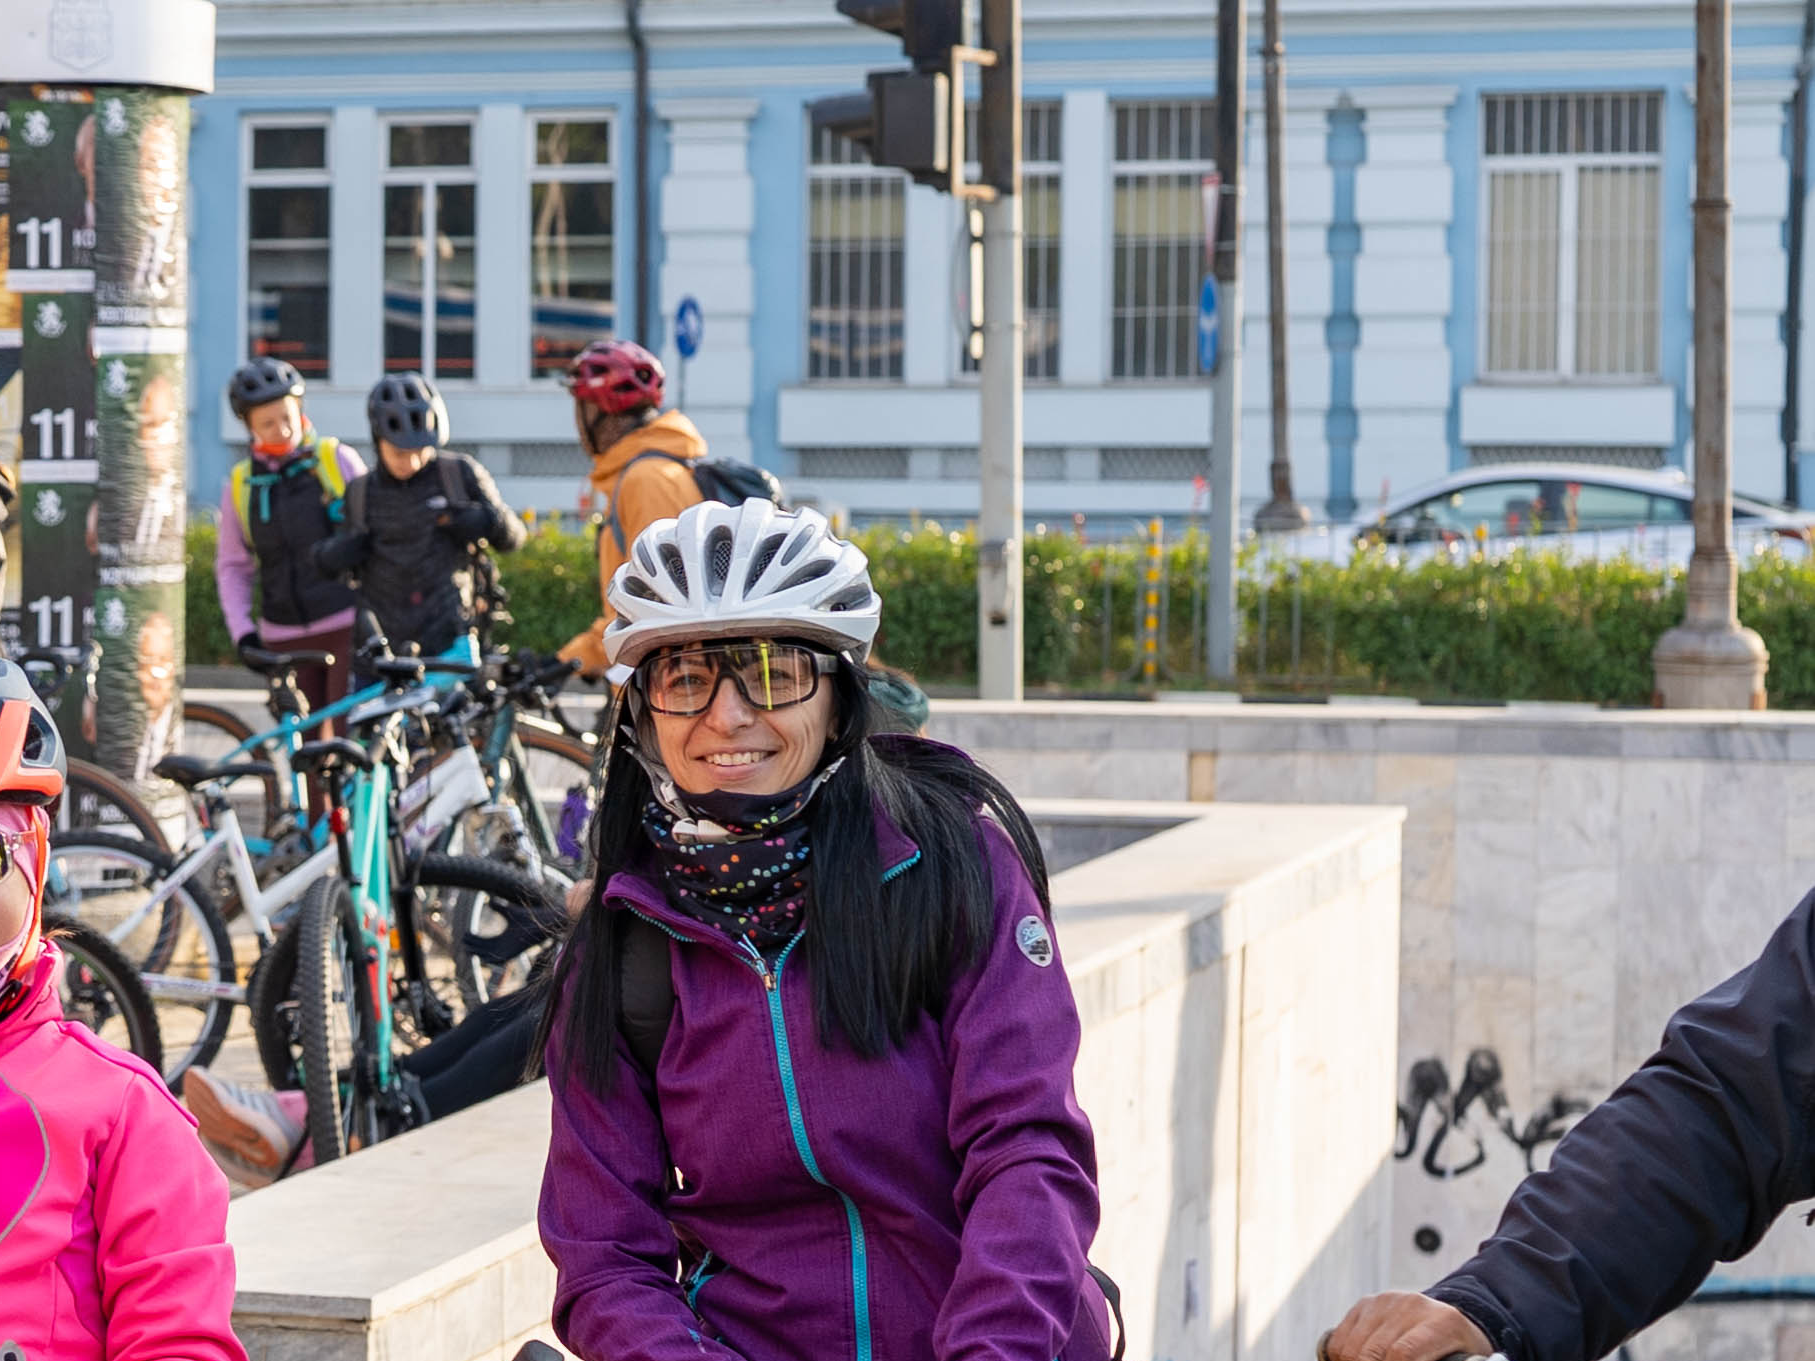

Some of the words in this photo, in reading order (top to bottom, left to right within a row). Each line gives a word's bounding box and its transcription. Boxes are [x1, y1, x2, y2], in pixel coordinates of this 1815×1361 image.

[16, 217, 62, 268] 11
[30, 407, 75, 459] 11
[28, 595, 73, 648] 11
